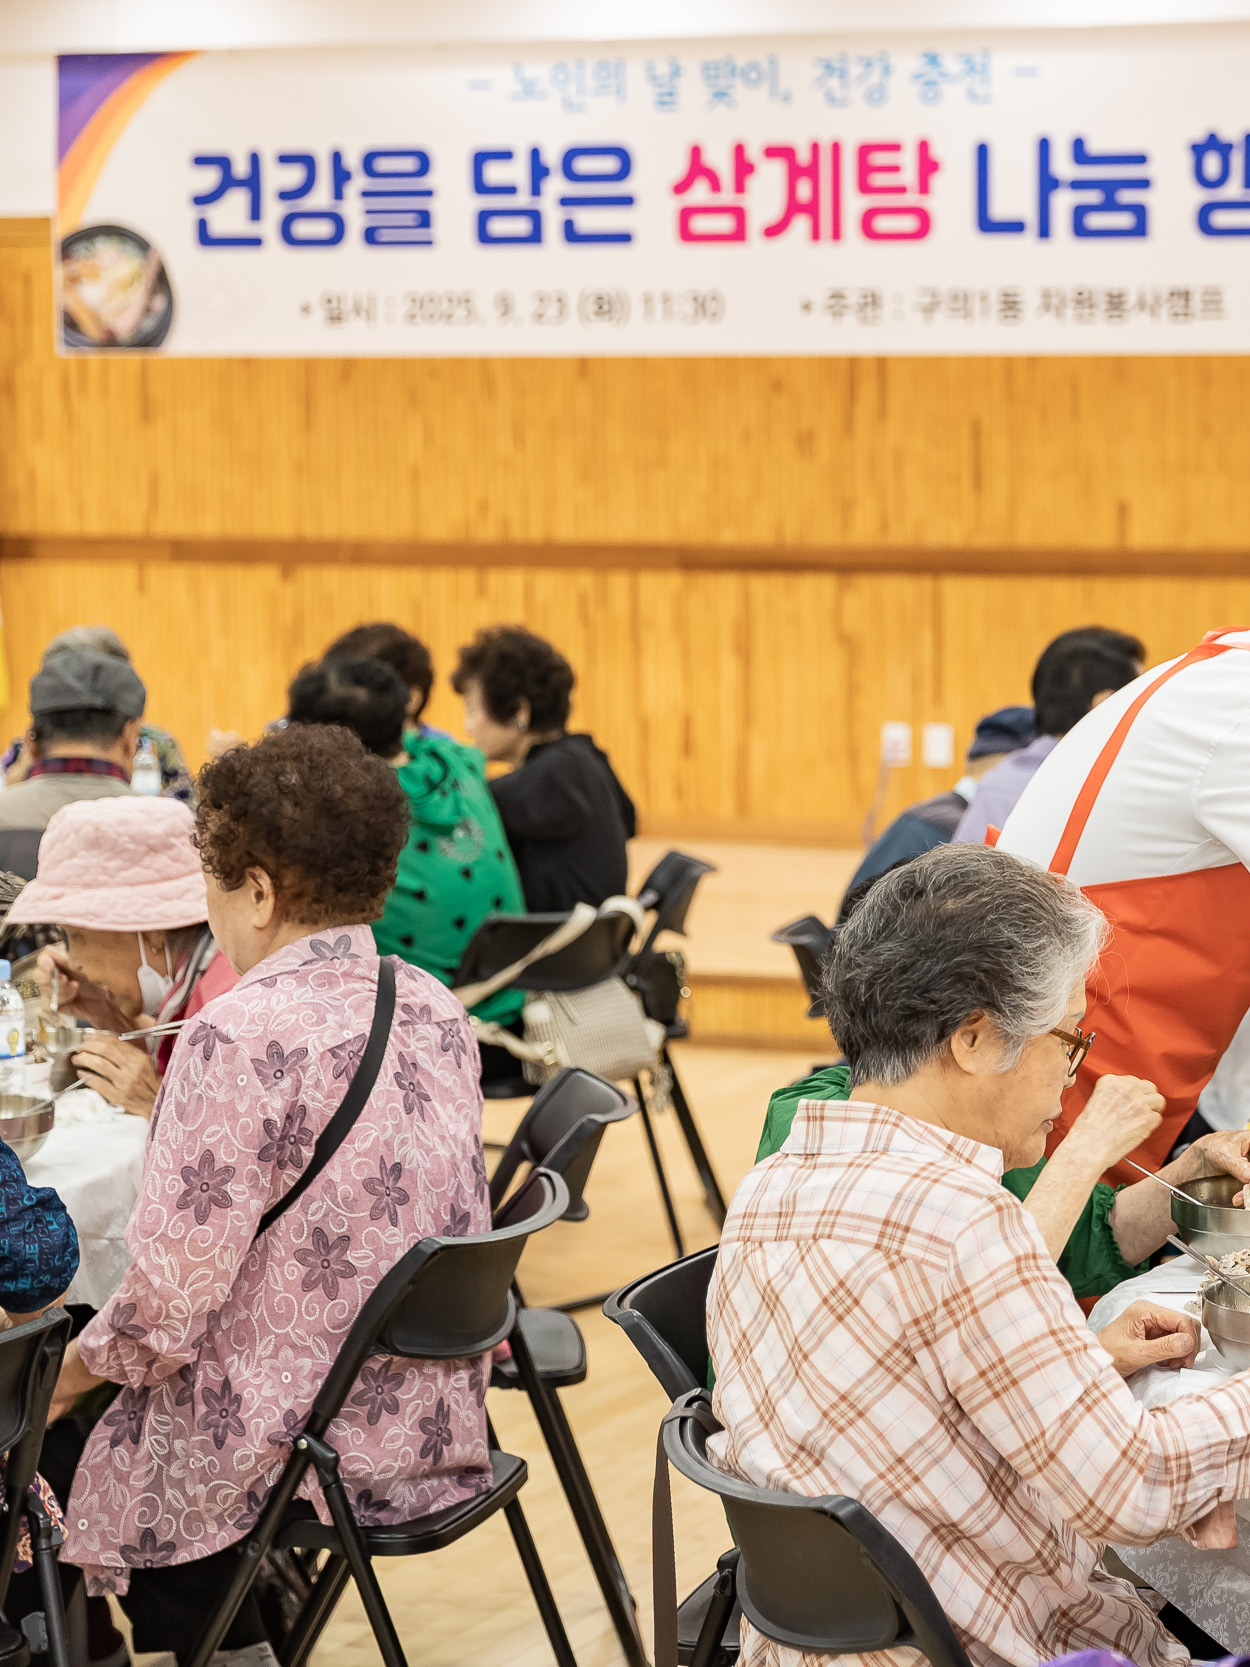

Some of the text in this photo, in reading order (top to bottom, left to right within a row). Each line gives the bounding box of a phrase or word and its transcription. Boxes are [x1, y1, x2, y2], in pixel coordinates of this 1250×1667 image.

[509, 56, 627, 113] 노인의
[645, 54, 681, 112] 날
[812, 50, 892, 108] 건강
[909, 48, 993, 107] 충전
[193, 149, 434, 246] 건강을
[473, 146, 635, 244] 담은
[673, 139, 941, 243] 삼계탕
[977, 136, 1151, 239] 나눔
[403, 289, 488, 328] 2025.
[494, 288, 525, 328] 9.
[531, 289, 570, 327] 23
[643, 289, 727, 327] 11:30
